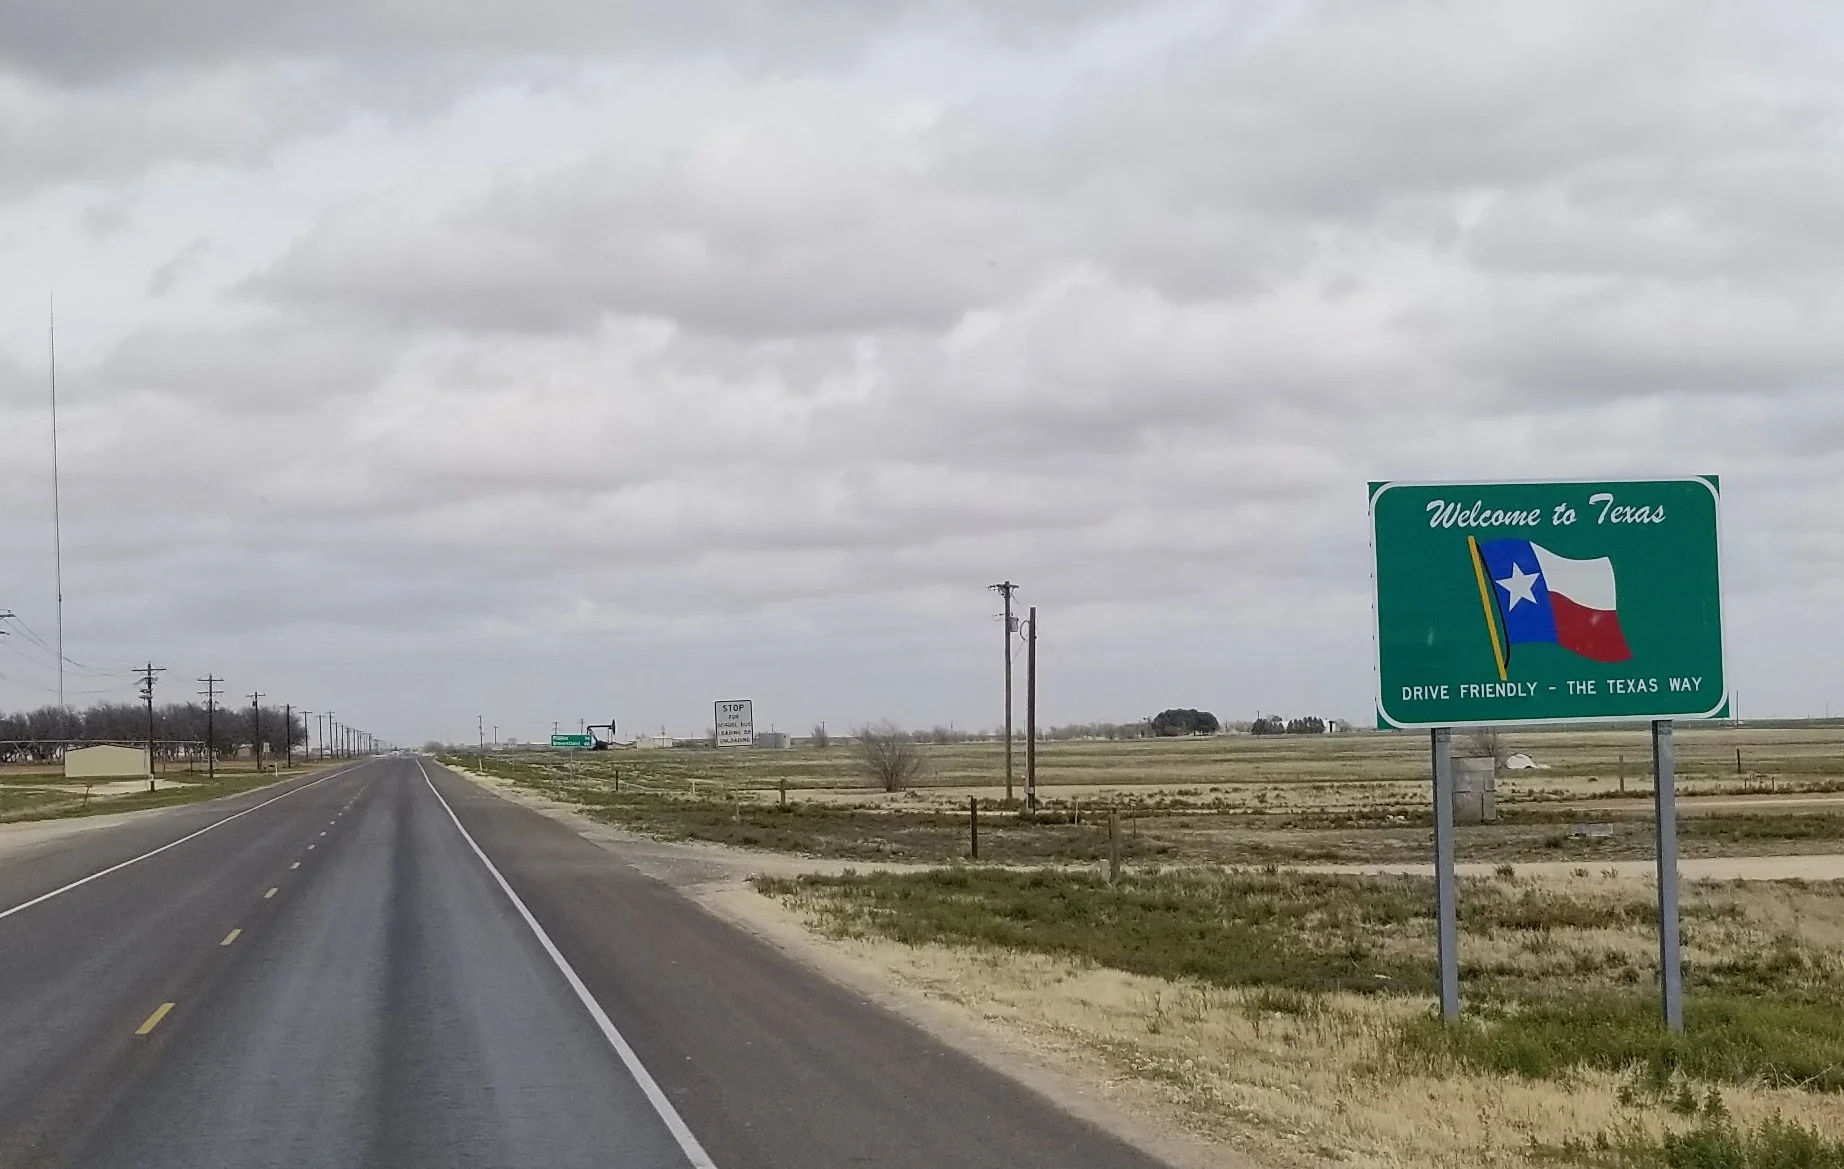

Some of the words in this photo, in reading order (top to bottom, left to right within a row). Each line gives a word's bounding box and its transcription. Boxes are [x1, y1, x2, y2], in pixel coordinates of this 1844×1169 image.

[1426, 500, 1541, 529] Welcome
[1552, 502, 1577, 525] to
[1589, 493, 1666, 525] Texas
[1402, 685, 1450, 701] DRIVE
[1460, 681, 1538, 699] FRIENDLY
[1567, 680, 1597, 696] THE
[1607, 678, 1658, 694] TEXAS
[1669, 677, 1703, 692] WAY
[722, 704, 744, 712] STOP
